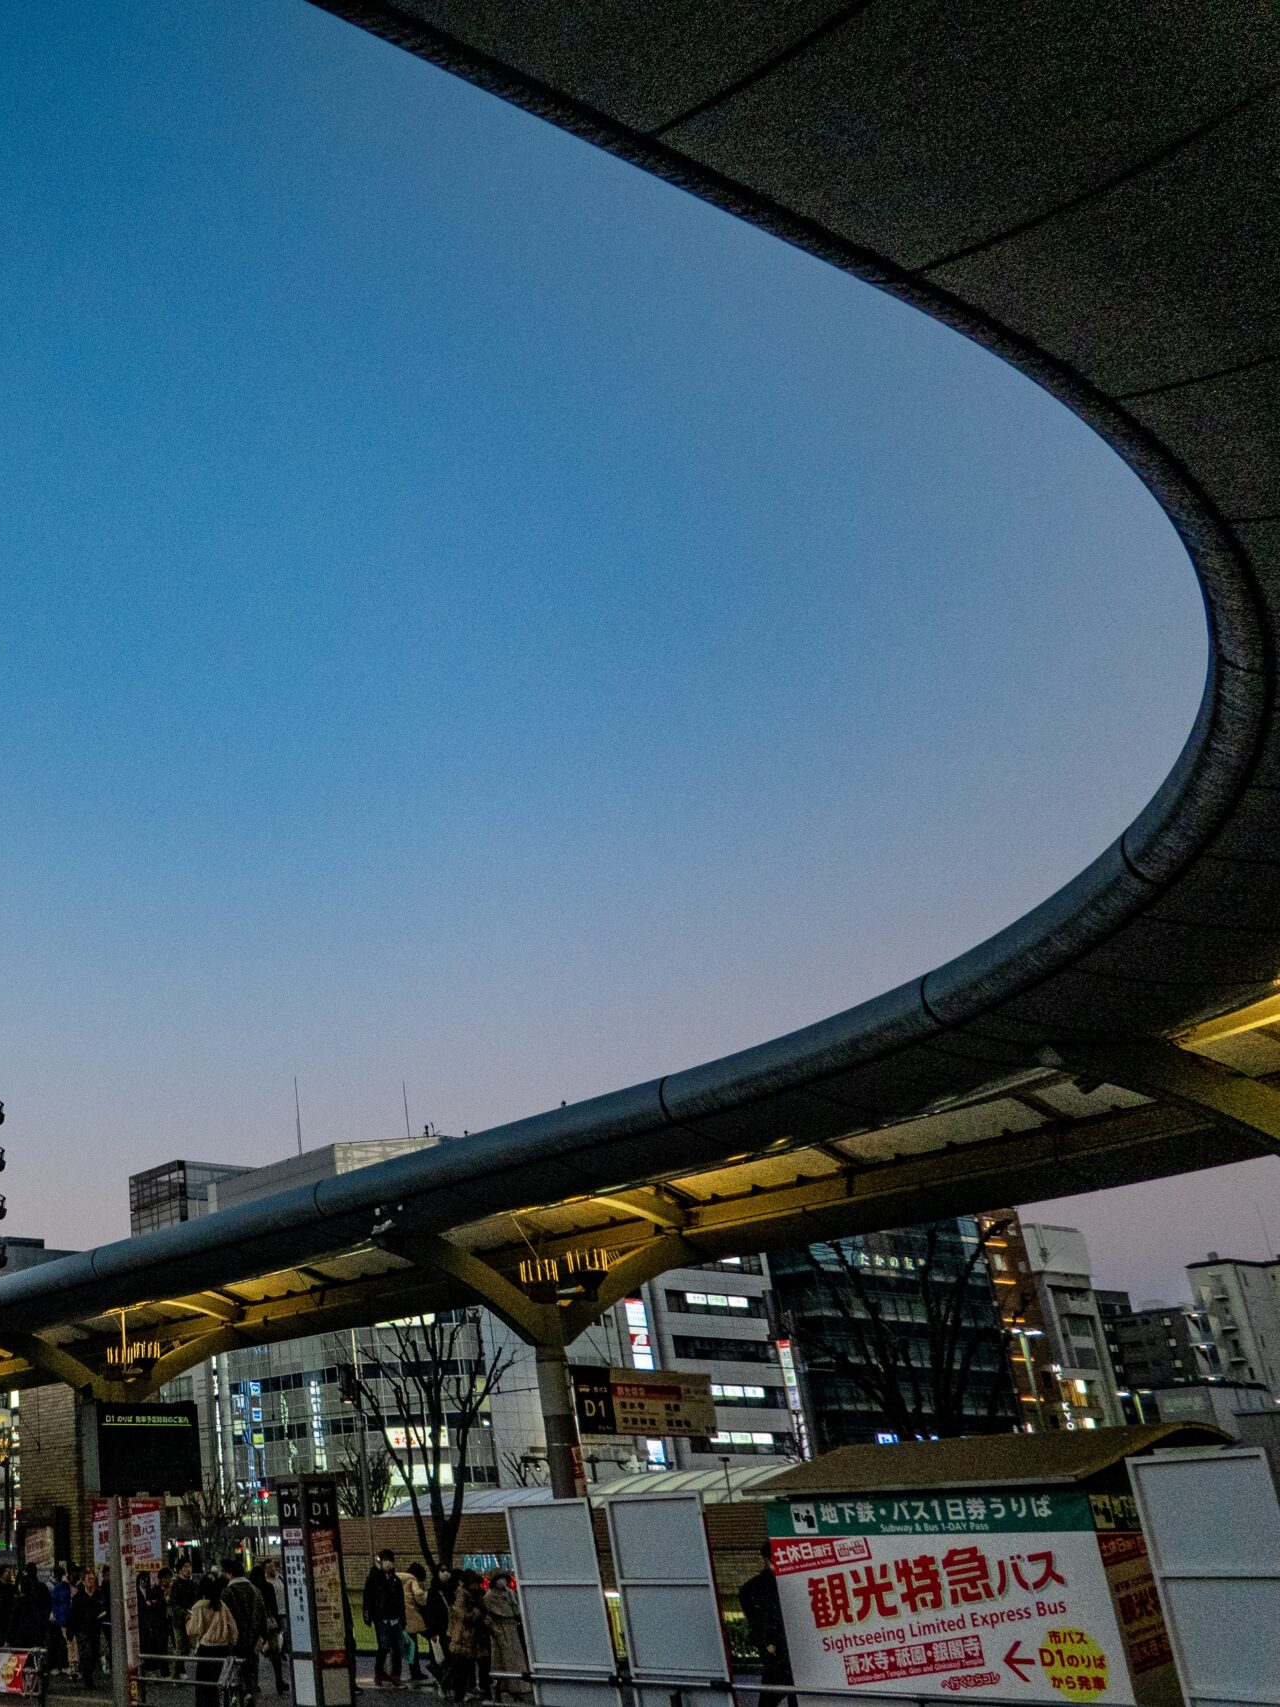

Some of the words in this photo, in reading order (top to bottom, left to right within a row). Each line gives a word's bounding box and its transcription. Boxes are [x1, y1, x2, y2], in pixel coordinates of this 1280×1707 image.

[584, 1399, 606, 1418] D1
[105, 1415, 115, 1423] D1
[283, 1503, 297, 1517] D1
[312, 1502, 329, 1516] D1
[820, 1497, 1053, 1524] 地下鉄・バス1日券うりば
[880, 1523, 912, 1534] Subway
[915, 1523, 922, 1532] &
[923, 1523, 939, 1532] Bus
[941, 1522, 967, 1532] 1-DAY
[970, 1521, 989, 1531] Pass
[774, 1542, 833, 1565] 土休日運行
[808, 1546, 1066, 1629] 観光特急バス
[822, 1627, 906, 1653] Sightseeing
[910, 1614, 966, 1638] Limited
[970, 1606, 1031, 1630] Express
[1037, 1600, 1067, 1617] Bus
[1047, 1630, 1088, 1645] 市バス
[845, 1637, 981, 1674] 清水寺・祇園・銀閣寺
[1038, 1647, 1107, 1670] D1のりば
[908, 1666, 921, 1675] Gion
[923, 1664, 933, 1673] and
[962, 1657, 983, 1668] Temple
[941, 1672, 1001, 1691] へ行くならコレ
[1051, 1675, 1107, 1691] から発車
